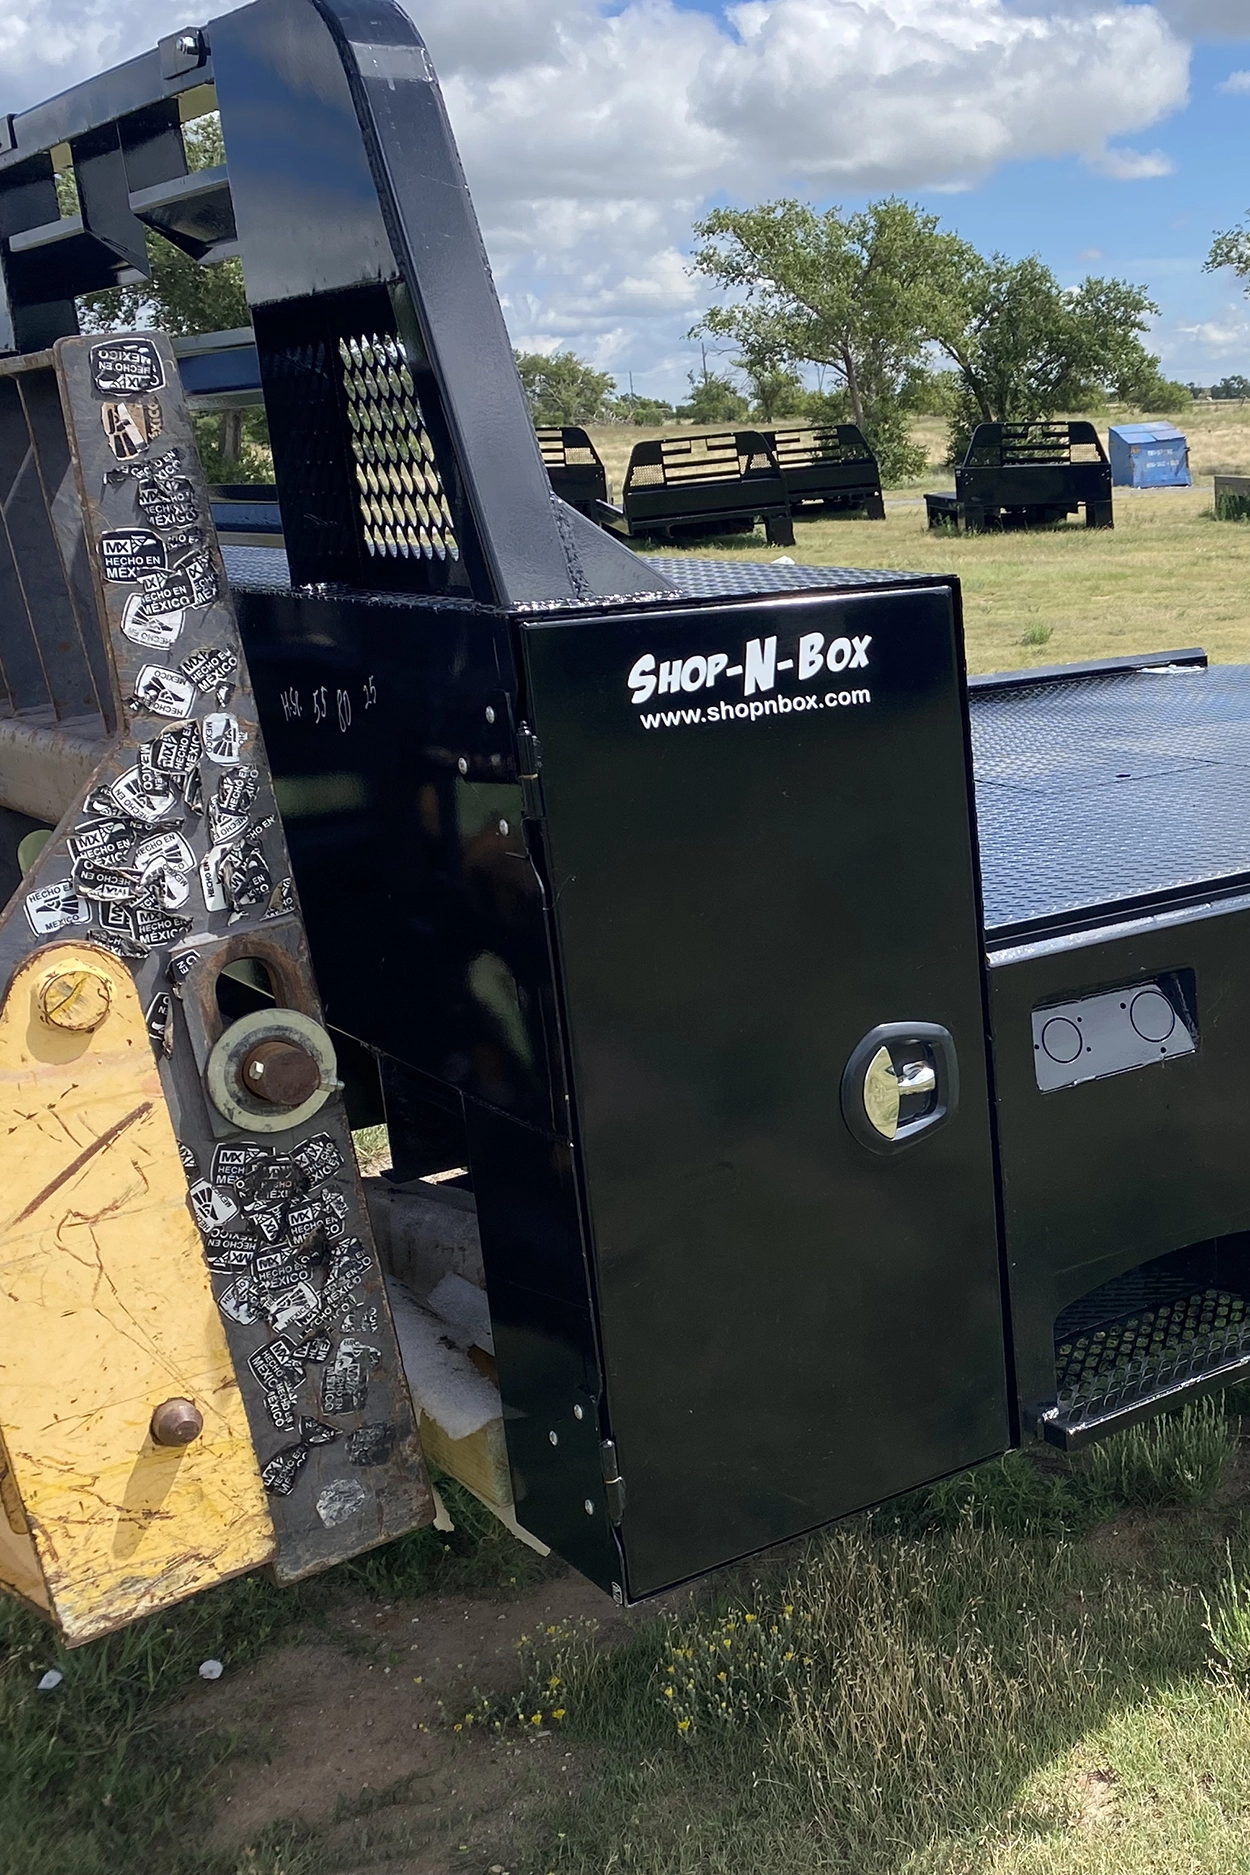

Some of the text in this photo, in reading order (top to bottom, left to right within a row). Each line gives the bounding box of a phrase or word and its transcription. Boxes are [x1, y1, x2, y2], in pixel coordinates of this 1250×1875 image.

[98, 361, 150, 375] HECHO EN
[104, 541, 130, 555] MX
[105, 556, 160, 566] HECHO EN
[173, 586, 187, 596] EN
[183, 650, 206, 671] MX
[190, 657, 219, 683] HECHO
[154, 703, 184, 716] HECHO
[336, 688, 352, 733] 80
[362, 674, 377, 710] 25
[639, 688, 871, 730] www.shopnbox.com
[174, 737, 189, 770] HECHO
[114, 788, 126, 801] EN
[78, 832, 101, 850] MX
[135, 833, 176, 858] HECHO EN
[80, 838, 131, 860] HECHO EN
[80, 870, 132, 886] HECHO EN
[251, 874, 265, 886] EN
[29, 885, 62, 903] HECHO
[44, 913, 80, 931] MEXICO
[139, 912, 160, 923] MX
[139, 920, 172, 934] HECHO
[176, 961, 190, 975] EN
[221, 1151, 245, 1165] MX
[218, 1166, 245, 1174] HECH
[290, 1210, 312, 1225] MX
[207, 1238, 257, 1251] HECHO EN
[231, 1251, 253, 1265] MX
[258, 1256, 281, 1271] MX
[258, 1265, 293, 1281] HECHO
[270, 1271, 309, 1289] EXICO
[345, 1267, 357, 1279] EN
[272, 1342, 289, 1365] MX
[261, 1350, 284, 1378] HECHO
